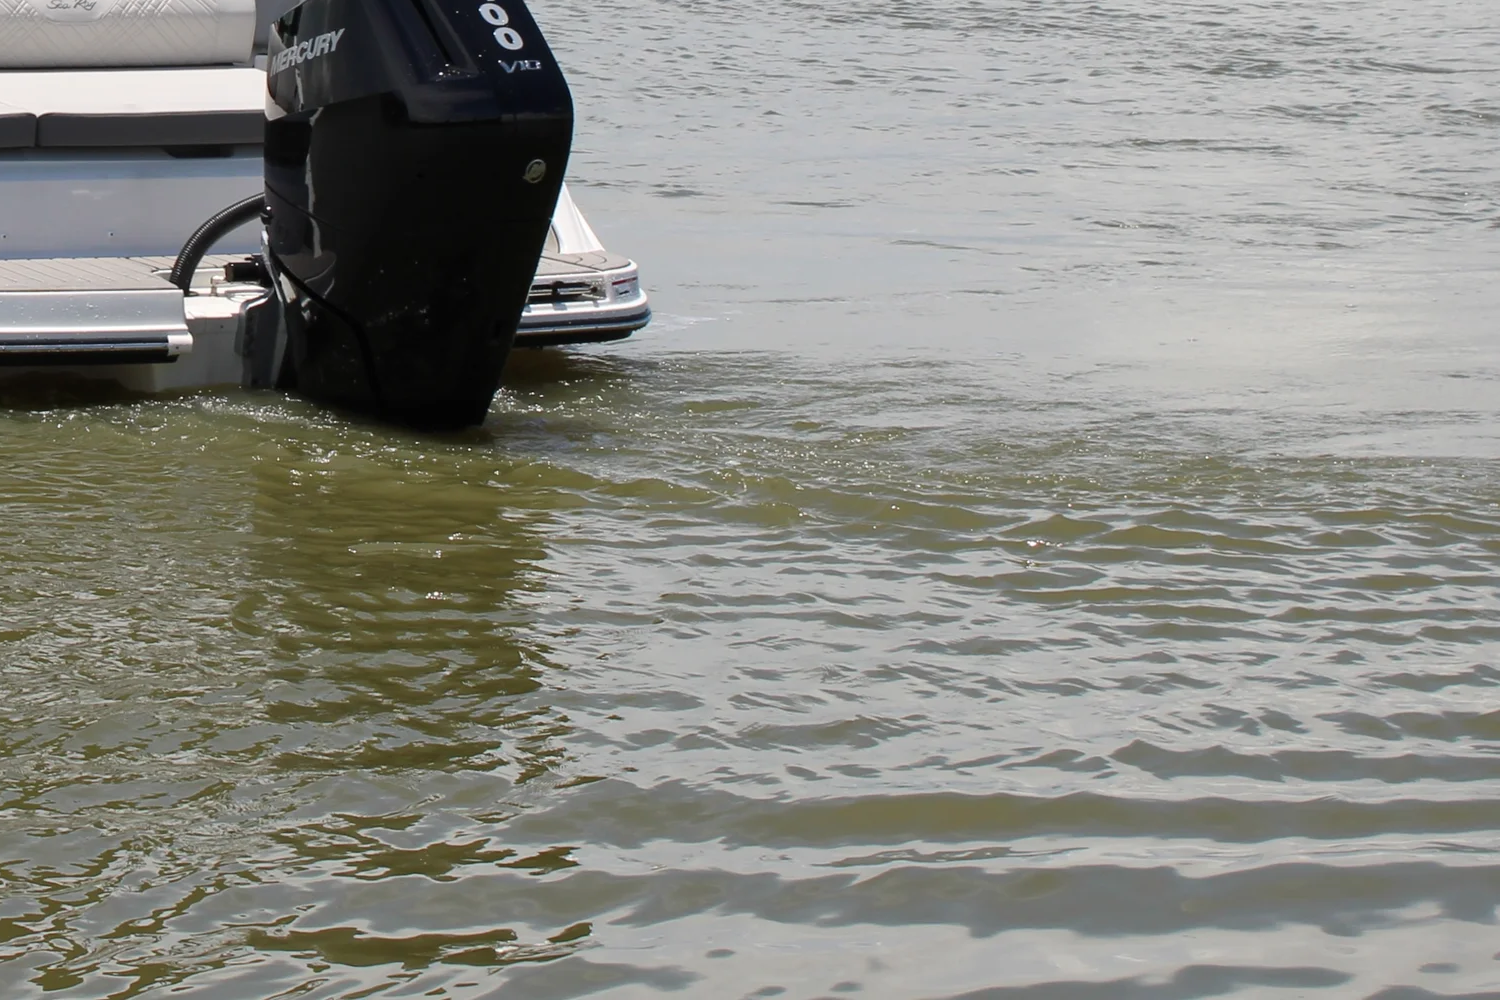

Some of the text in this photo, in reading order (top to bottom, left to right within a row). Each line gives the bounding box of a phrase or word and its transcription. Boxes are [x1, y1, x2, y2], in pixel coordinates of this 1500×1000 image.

[46, 0, 71, 10] Sea
[270, 28, 346, 77] MERCURY
[498, 59, 541, 73] V10
